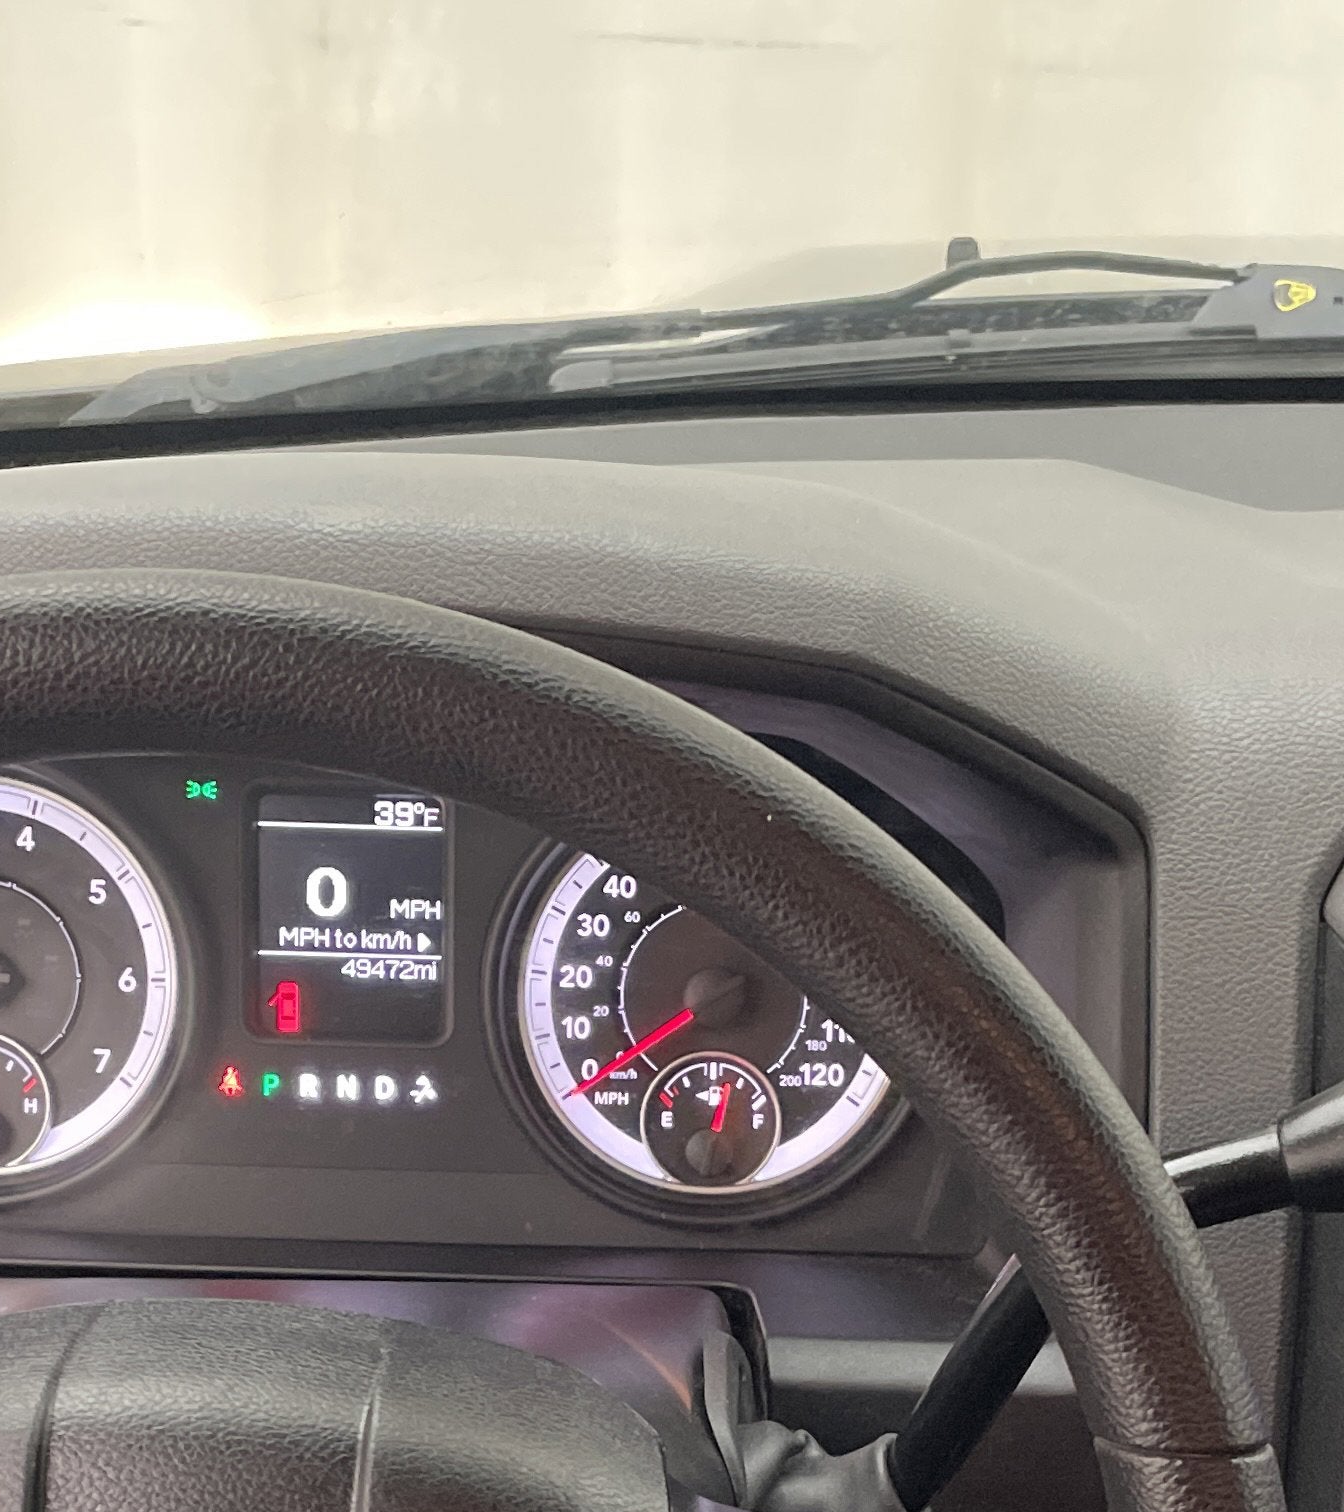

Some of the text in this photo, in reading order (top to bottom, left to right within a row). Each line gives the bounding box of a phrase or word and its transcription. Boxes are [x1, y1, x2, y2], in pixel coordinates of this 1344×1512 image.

[16, 825, 36, 852] 4
[88, 878, 107, 905] 5
[306, 866, 348, 920] 0
[602, 875, 637, 899] 40
[389, 898, 441, 921] MPH
[623, 910, 641, 923] 60
[576, 912, 611, 938] 30
[278, 926, 413, 951] MPH to km/h
[595, 955, 614, 967] 40
[118, 966, 137, 993] 6
[559, 963, 593, 989] 20
[592, 1005, 610, 1017] 20
[560, 1015, 592, 1040] 10
[821, 1018, 856, 1044] 11
[805, 1039, 828, 1052] 180
[93, 1048, 111, 1074] 7
[581, 1058, 599, 1081] 0
[262, 1073, 395, 1100] P R N D
[777, 1073, 803, 1088] 200
[798, 1062, 846, 1088] 120
[23, 1097, 38, 1114] H
[592, 1091, 630, 1108] MPH
[660, 1110, 673, 1128] E
[752, 1113, 765, 1130] F
